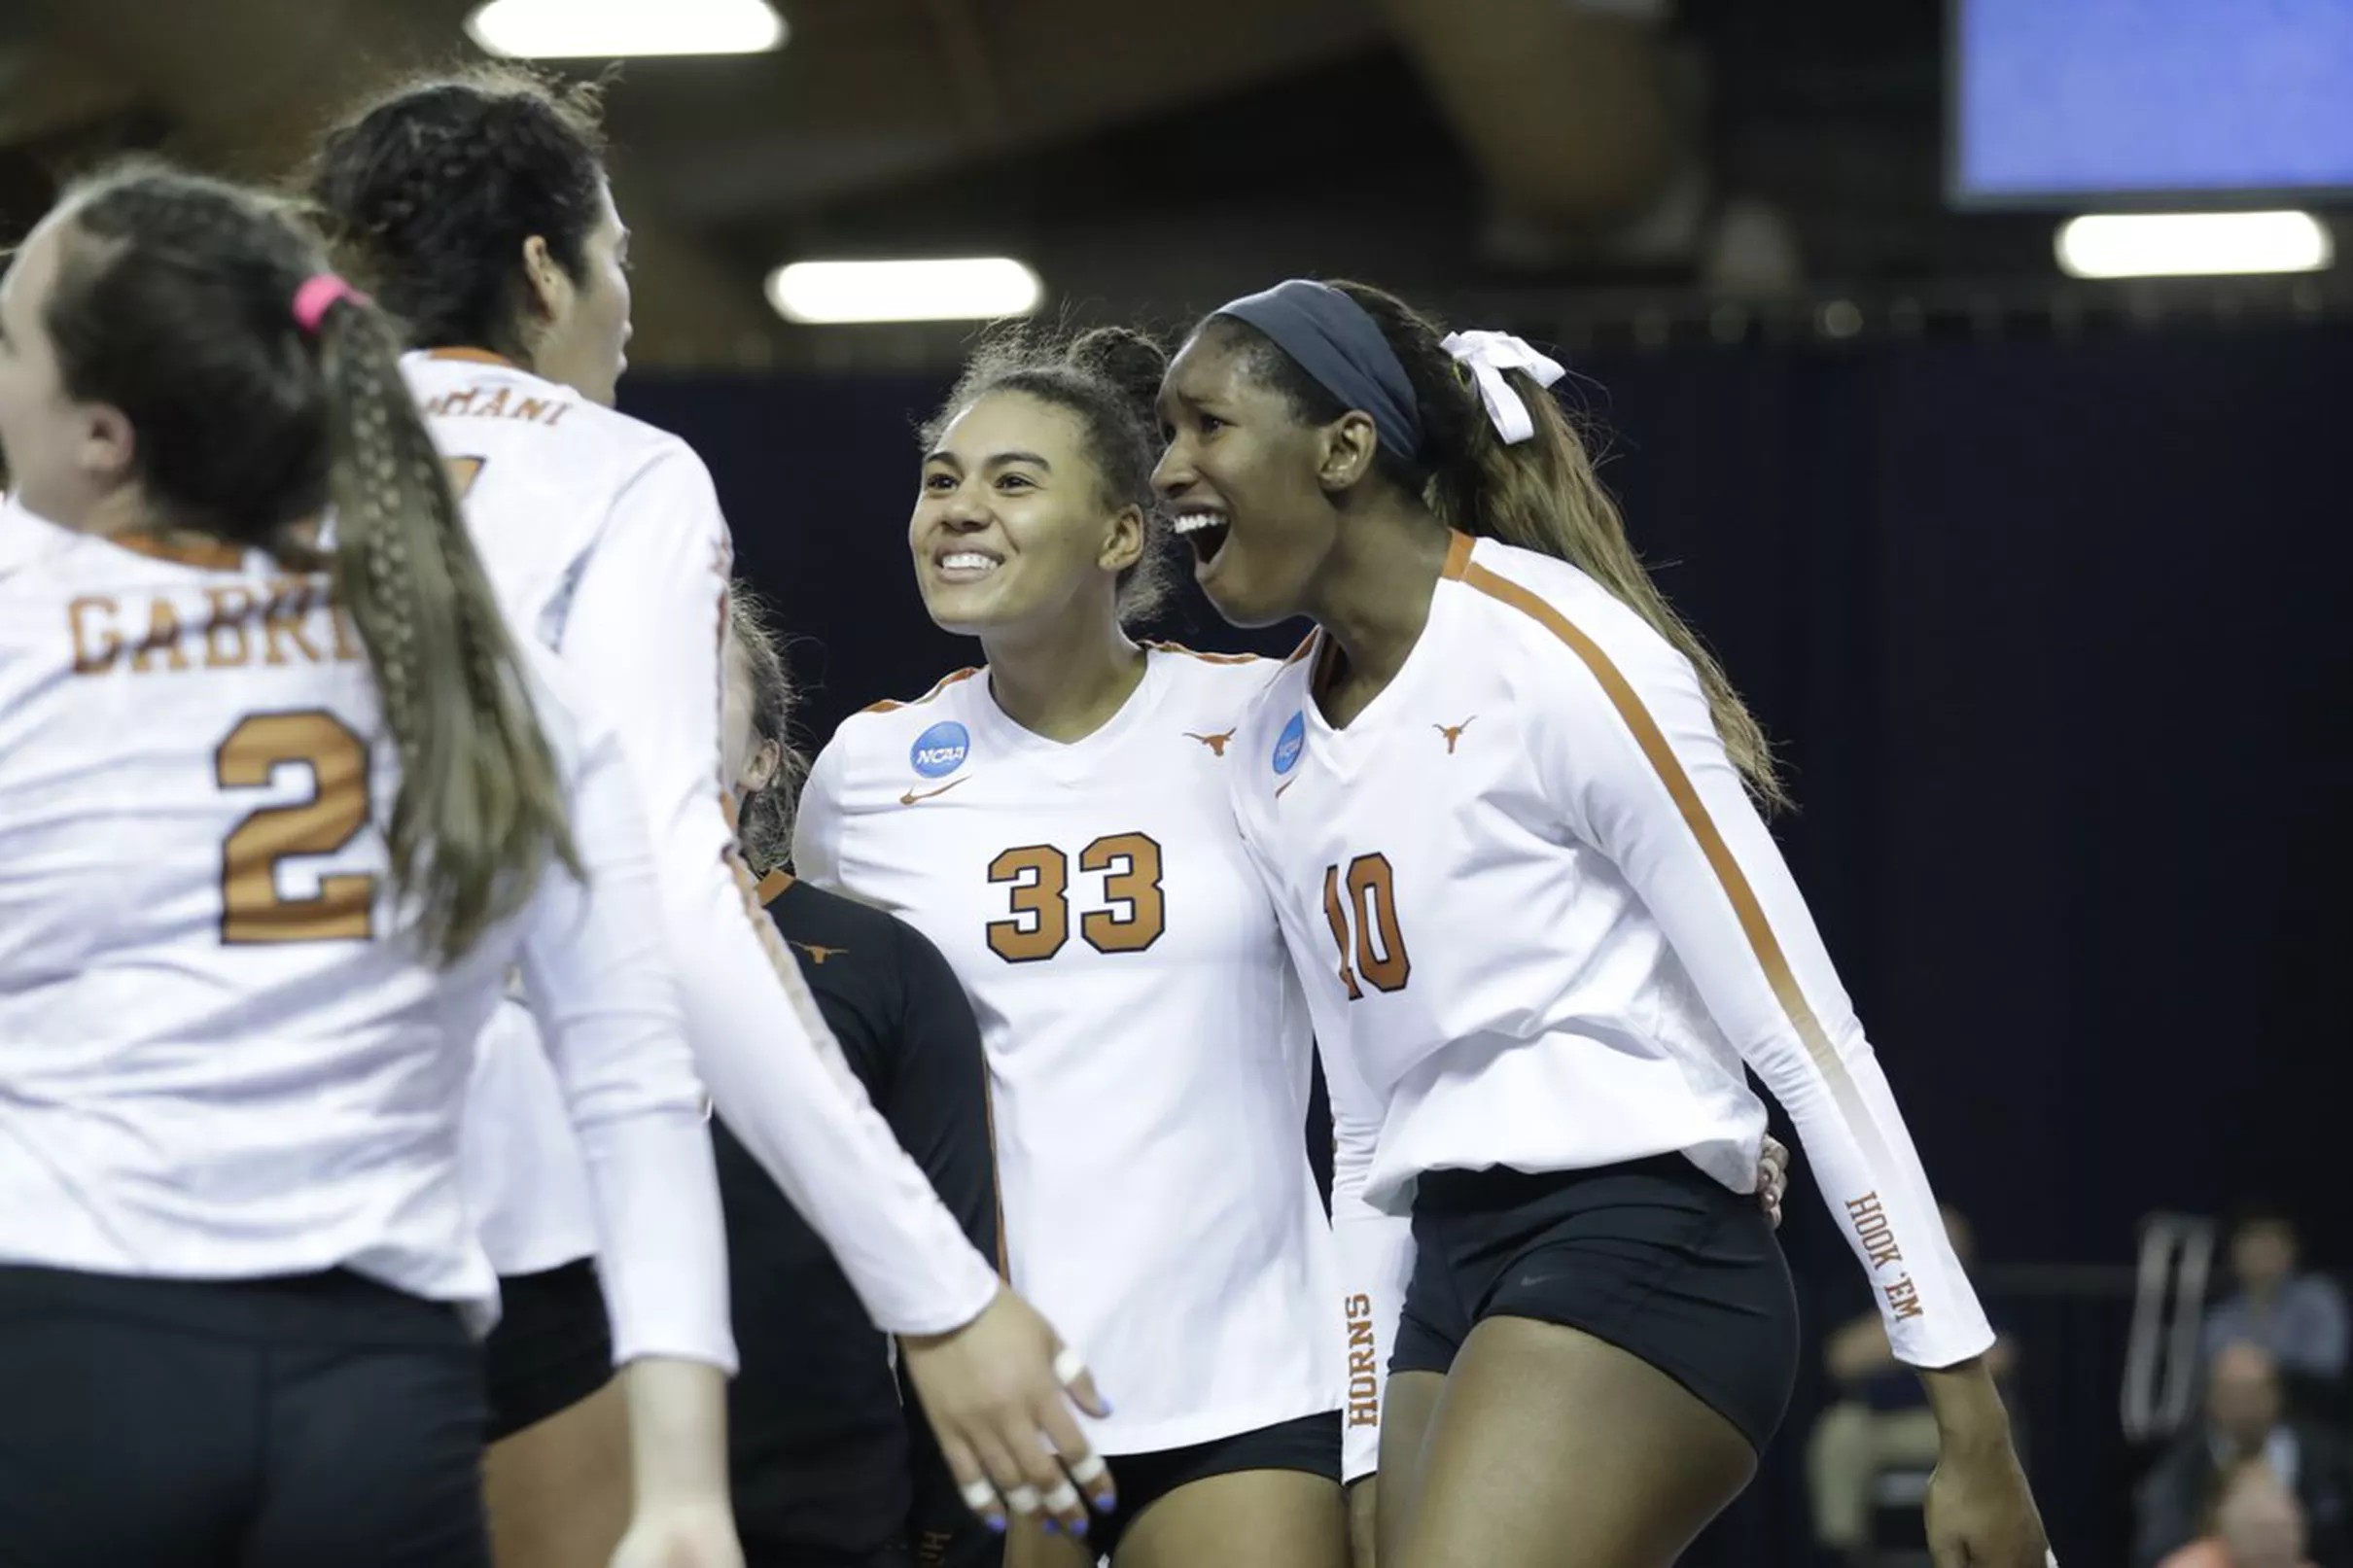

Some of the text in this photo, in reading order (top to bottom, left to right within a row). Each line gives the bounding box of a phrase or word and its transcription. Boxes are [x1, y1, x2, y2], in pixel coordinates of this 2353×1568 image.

[917, 747, 965, 765] NCAA
[216, 708, 374, 945] 2
[986, 831, 1166, 963] 33
[1323, 852, 1412, 1001] 10
[1844, 1191, 1924, 1323] HOOK 'EM
[1345, 1293, 1379, 1428] HORNS
